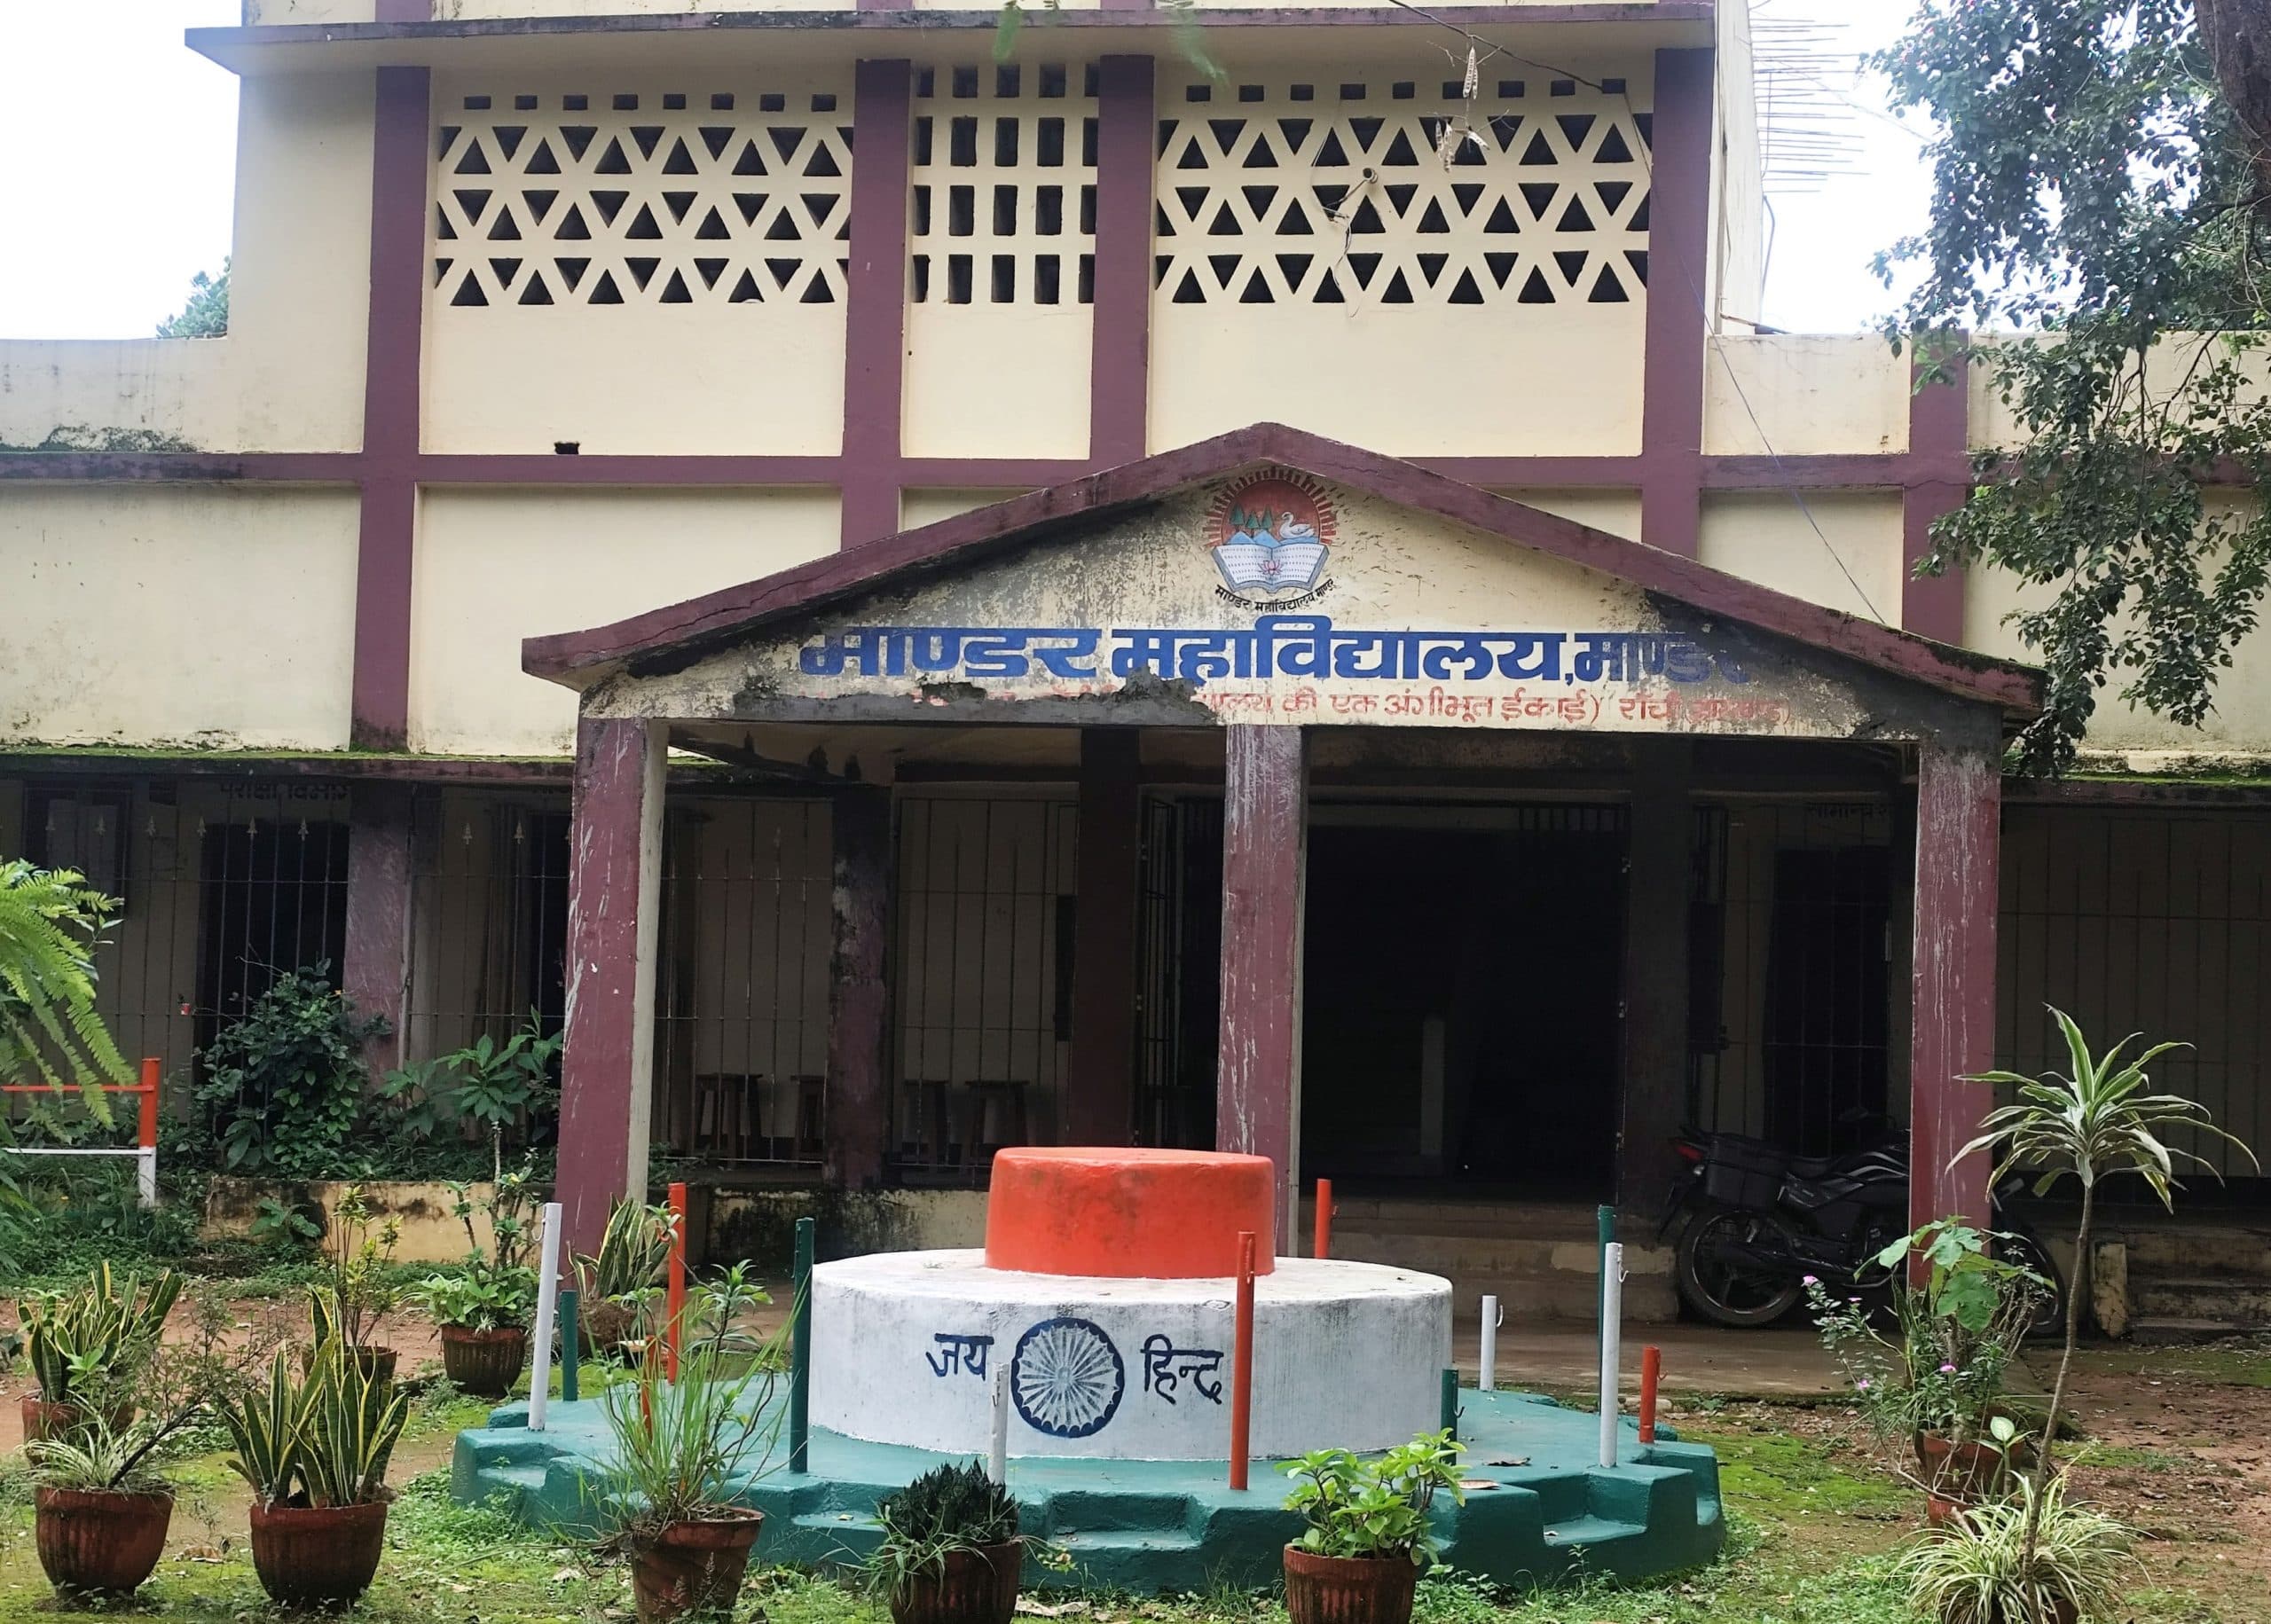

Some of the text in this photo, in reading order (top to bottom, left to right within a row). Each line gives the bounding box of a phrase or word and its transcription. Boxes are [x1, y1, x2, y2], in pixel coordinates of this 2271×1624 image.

[1215, 584, 1251, 610] माण्डर
[800, 626, 1102, 678] माण्डर
[1283, 686, 1317, 712] की
[1330, 694, 1380, 713] एक
[926, 1332, 1224, 1405] जय हिन्द
